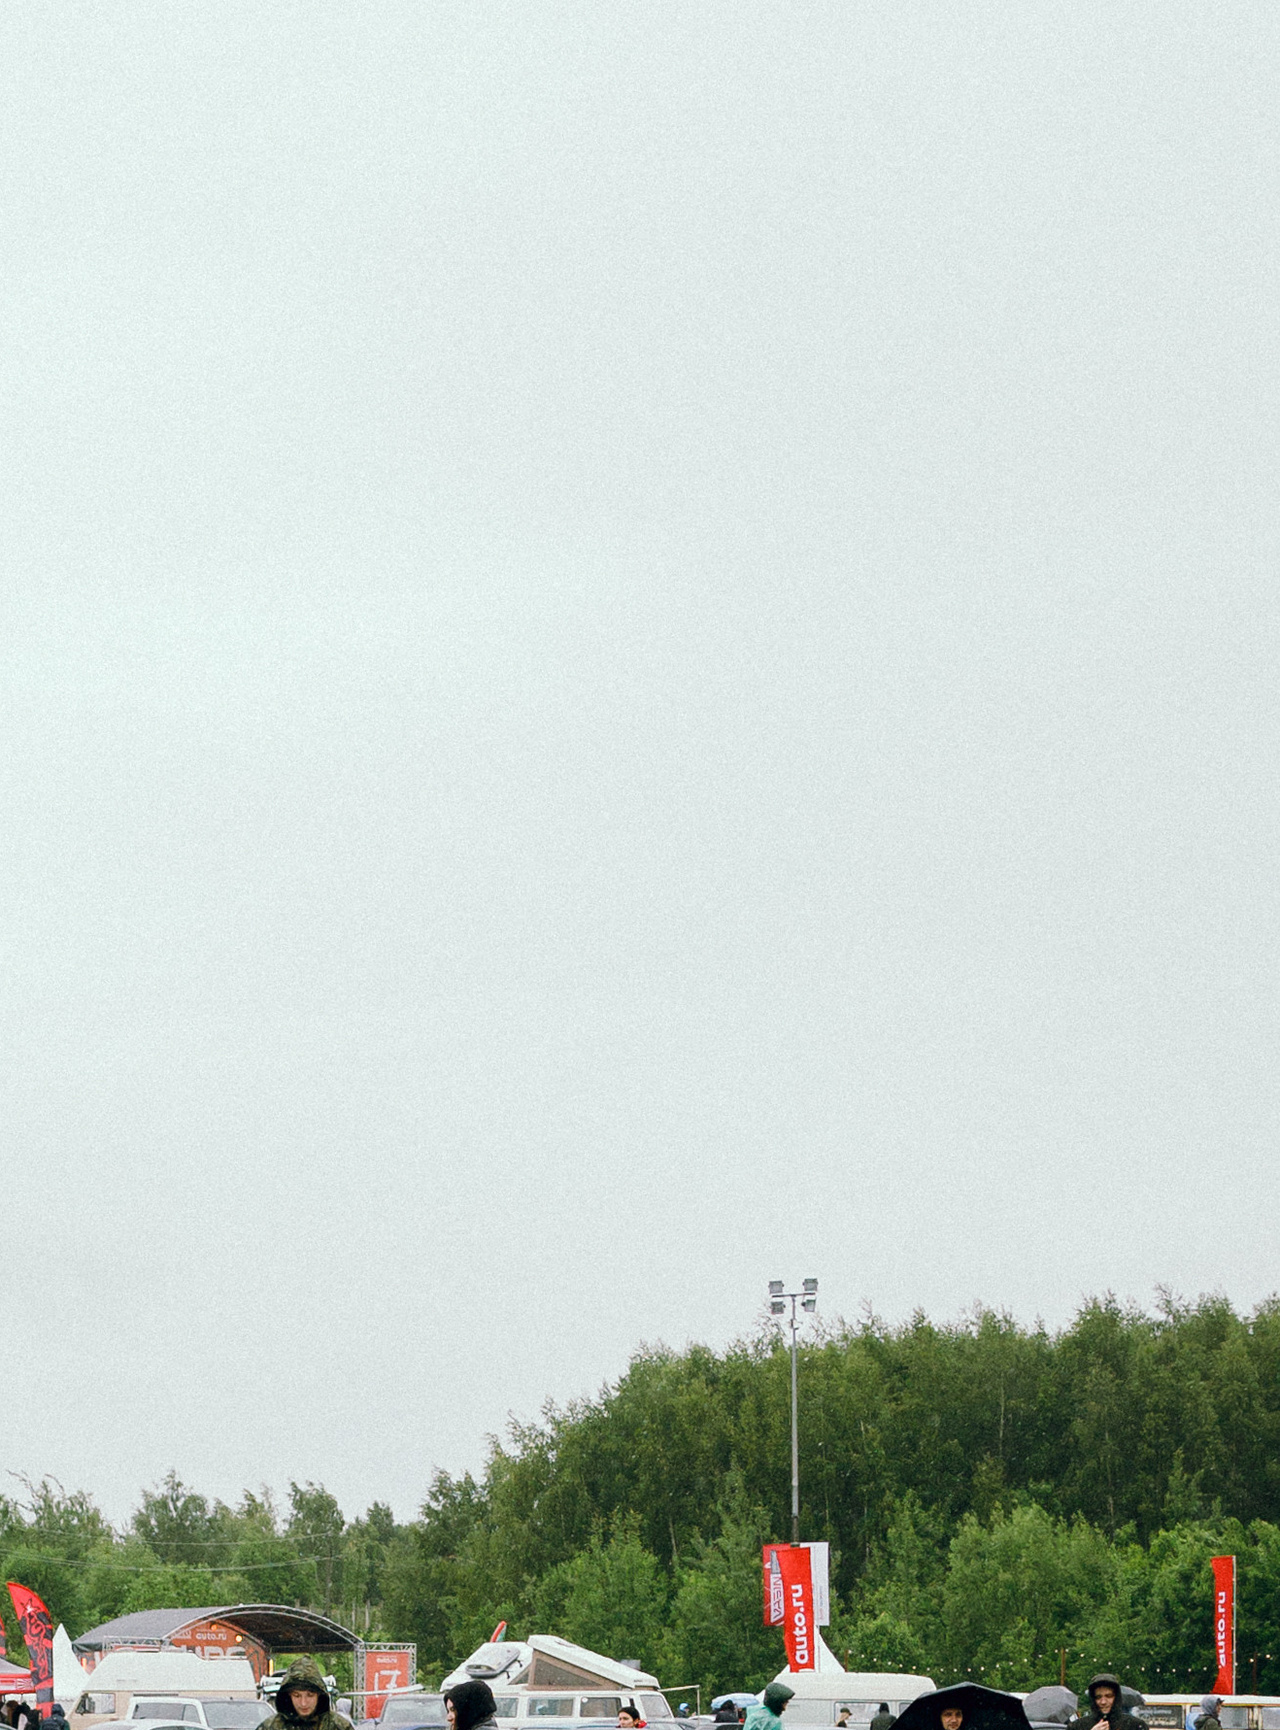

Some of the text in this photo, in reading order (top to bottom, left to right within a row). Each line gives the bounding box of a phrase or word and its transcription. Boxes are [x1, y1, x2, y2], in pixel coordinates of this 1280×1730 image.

[195, 1632, 227, 1641] auto.ru
[791, 1584, 809, 1664] auto.ru
[1218, 1592, 1226, 1667] auto.ru
